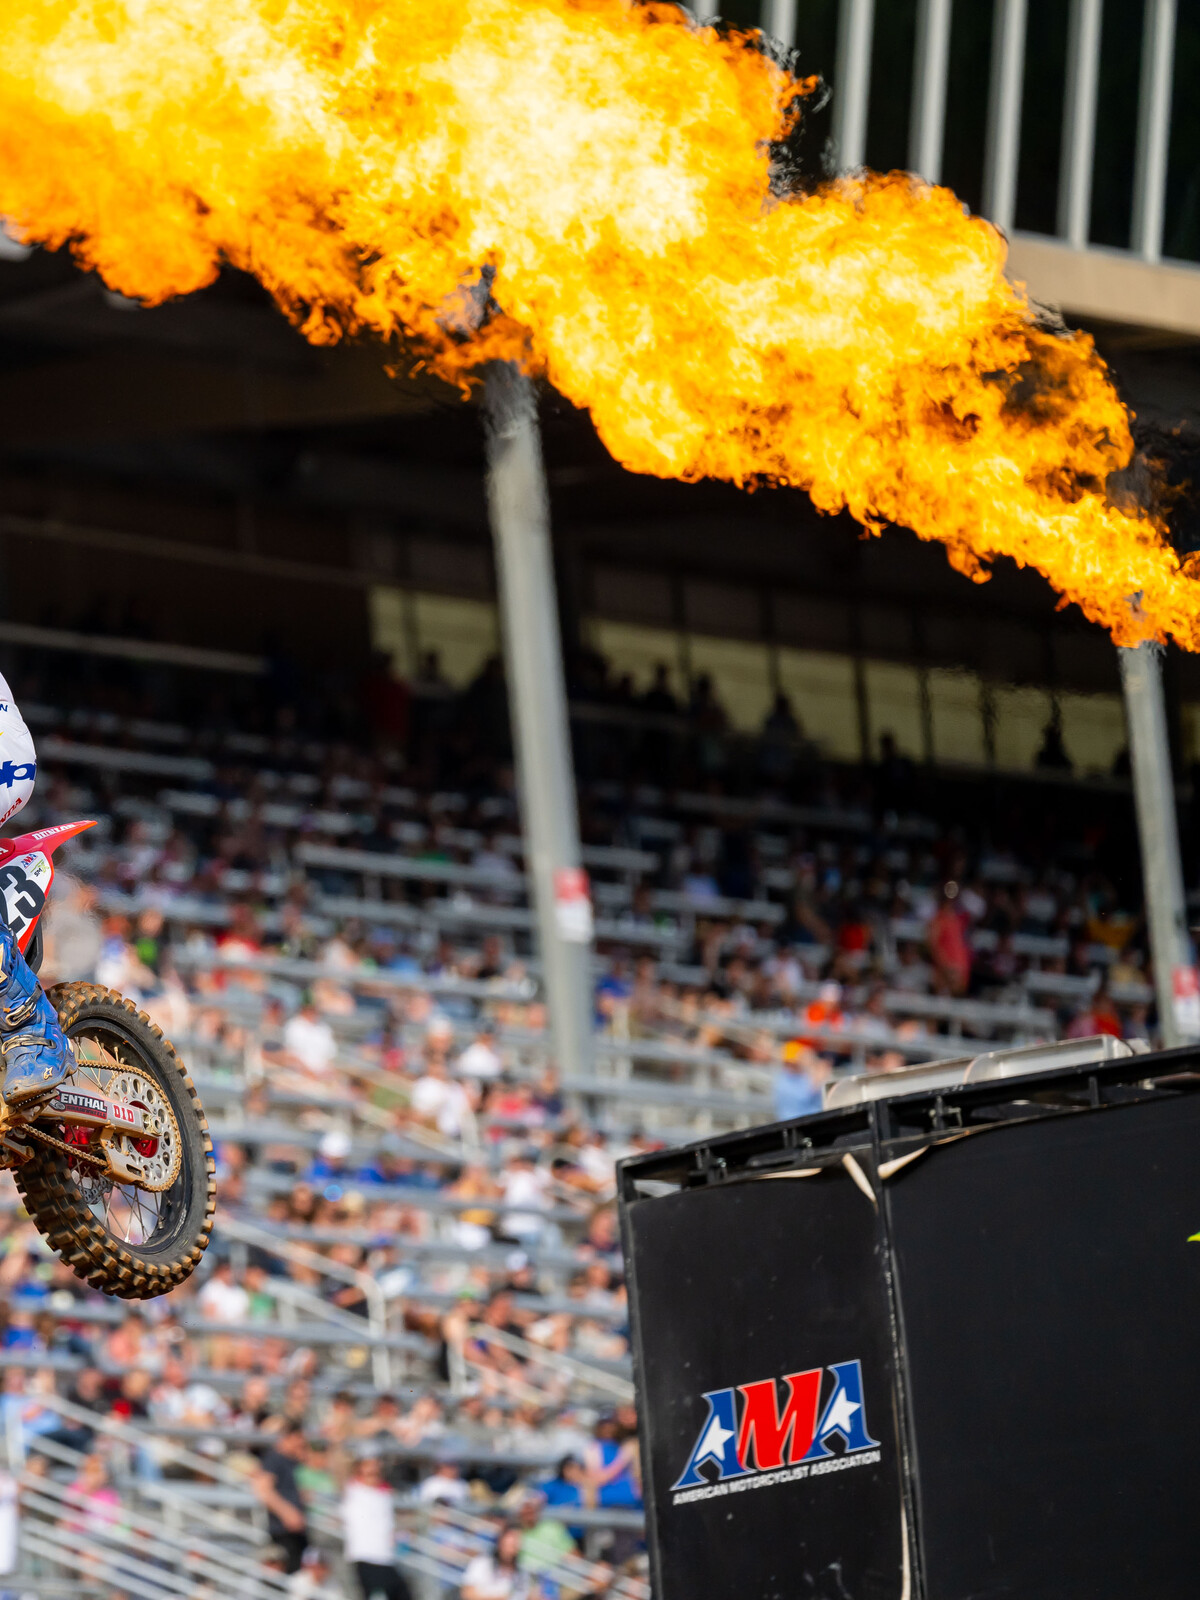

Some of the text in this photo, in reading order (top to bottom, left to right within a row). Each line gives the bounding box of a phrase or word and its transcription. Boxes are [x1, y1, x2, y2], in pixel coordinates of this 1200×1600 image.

[59, 1092, 107, 1112] ENTHAL
[669, 1359, 881, 1491] AMA
[672, 1450, 881, 1505] AMERICAN MOTORCYCLIST ASSOCIATION
